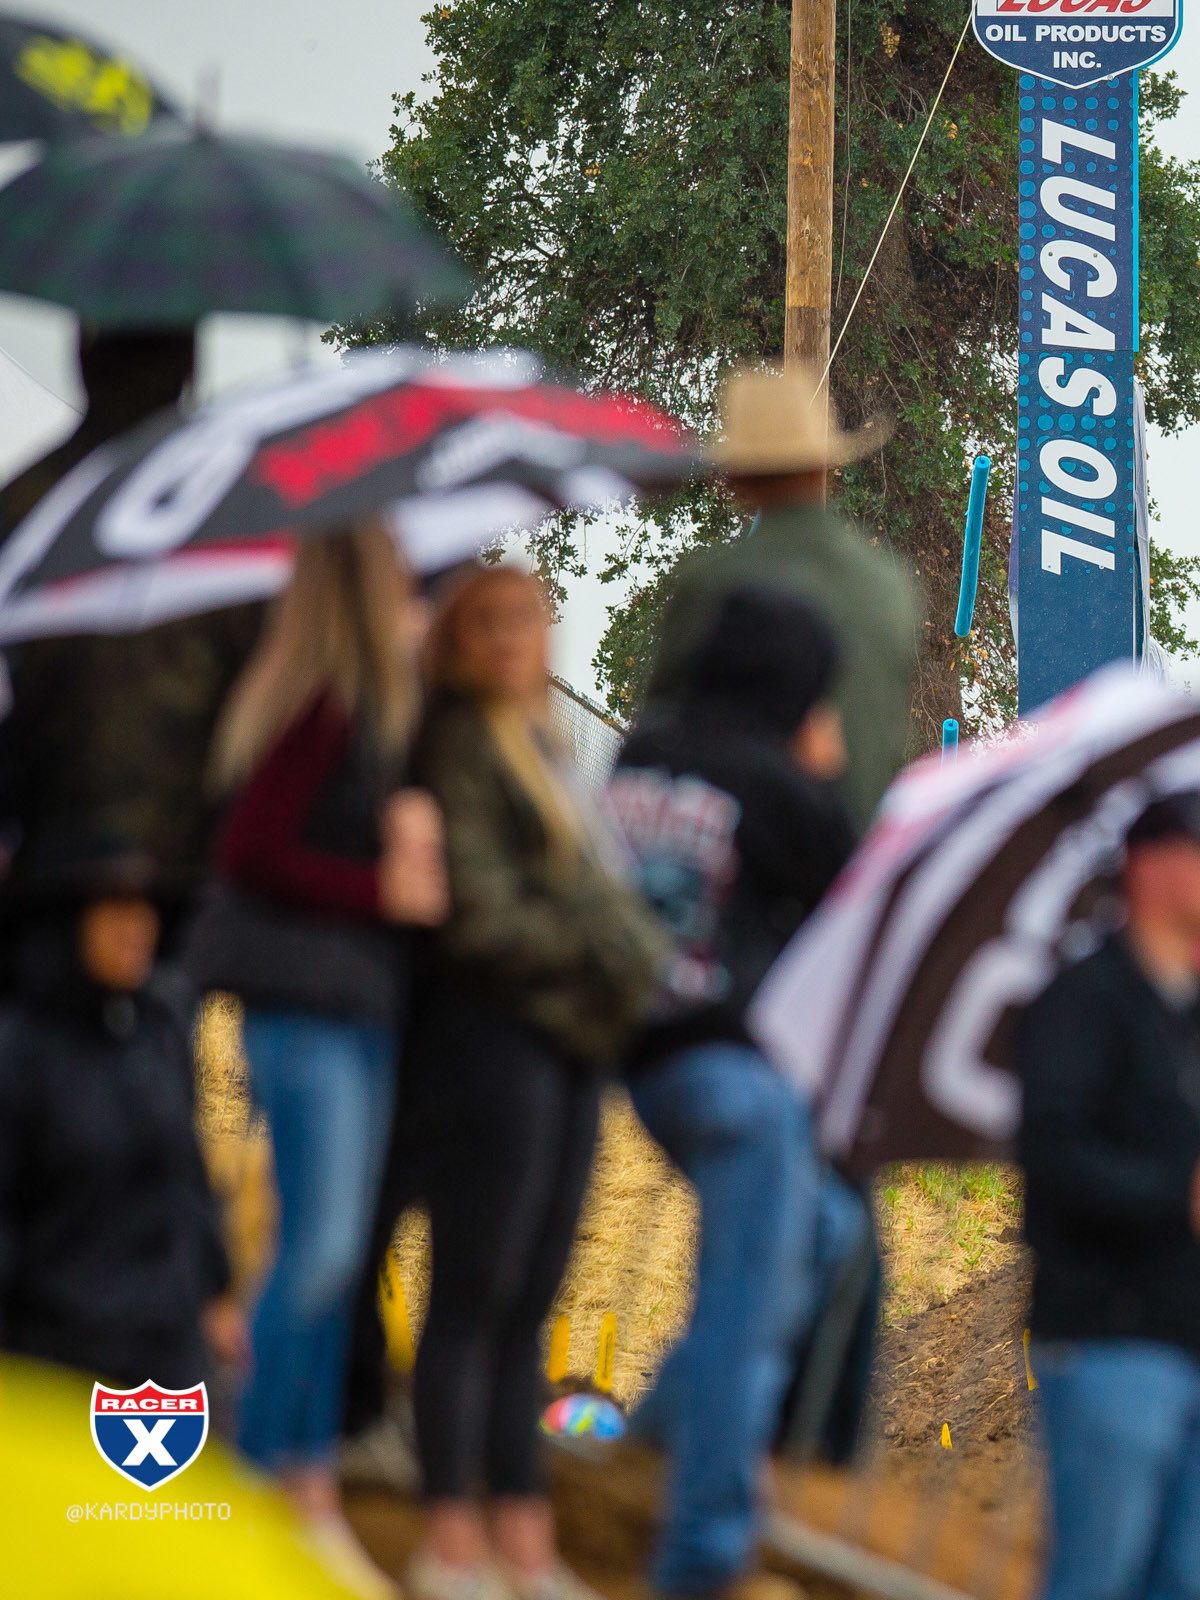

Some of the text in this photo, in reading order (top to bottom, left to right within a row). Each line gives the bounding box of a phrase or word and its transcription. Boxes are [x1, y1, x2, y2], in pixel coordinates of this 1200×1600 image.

[985, 25, 1167, 43] OIL PRODUCTS
[1053, 52, 1102, 69] INC.
[1039, 118, 1118, 576] LUCAS OIL
